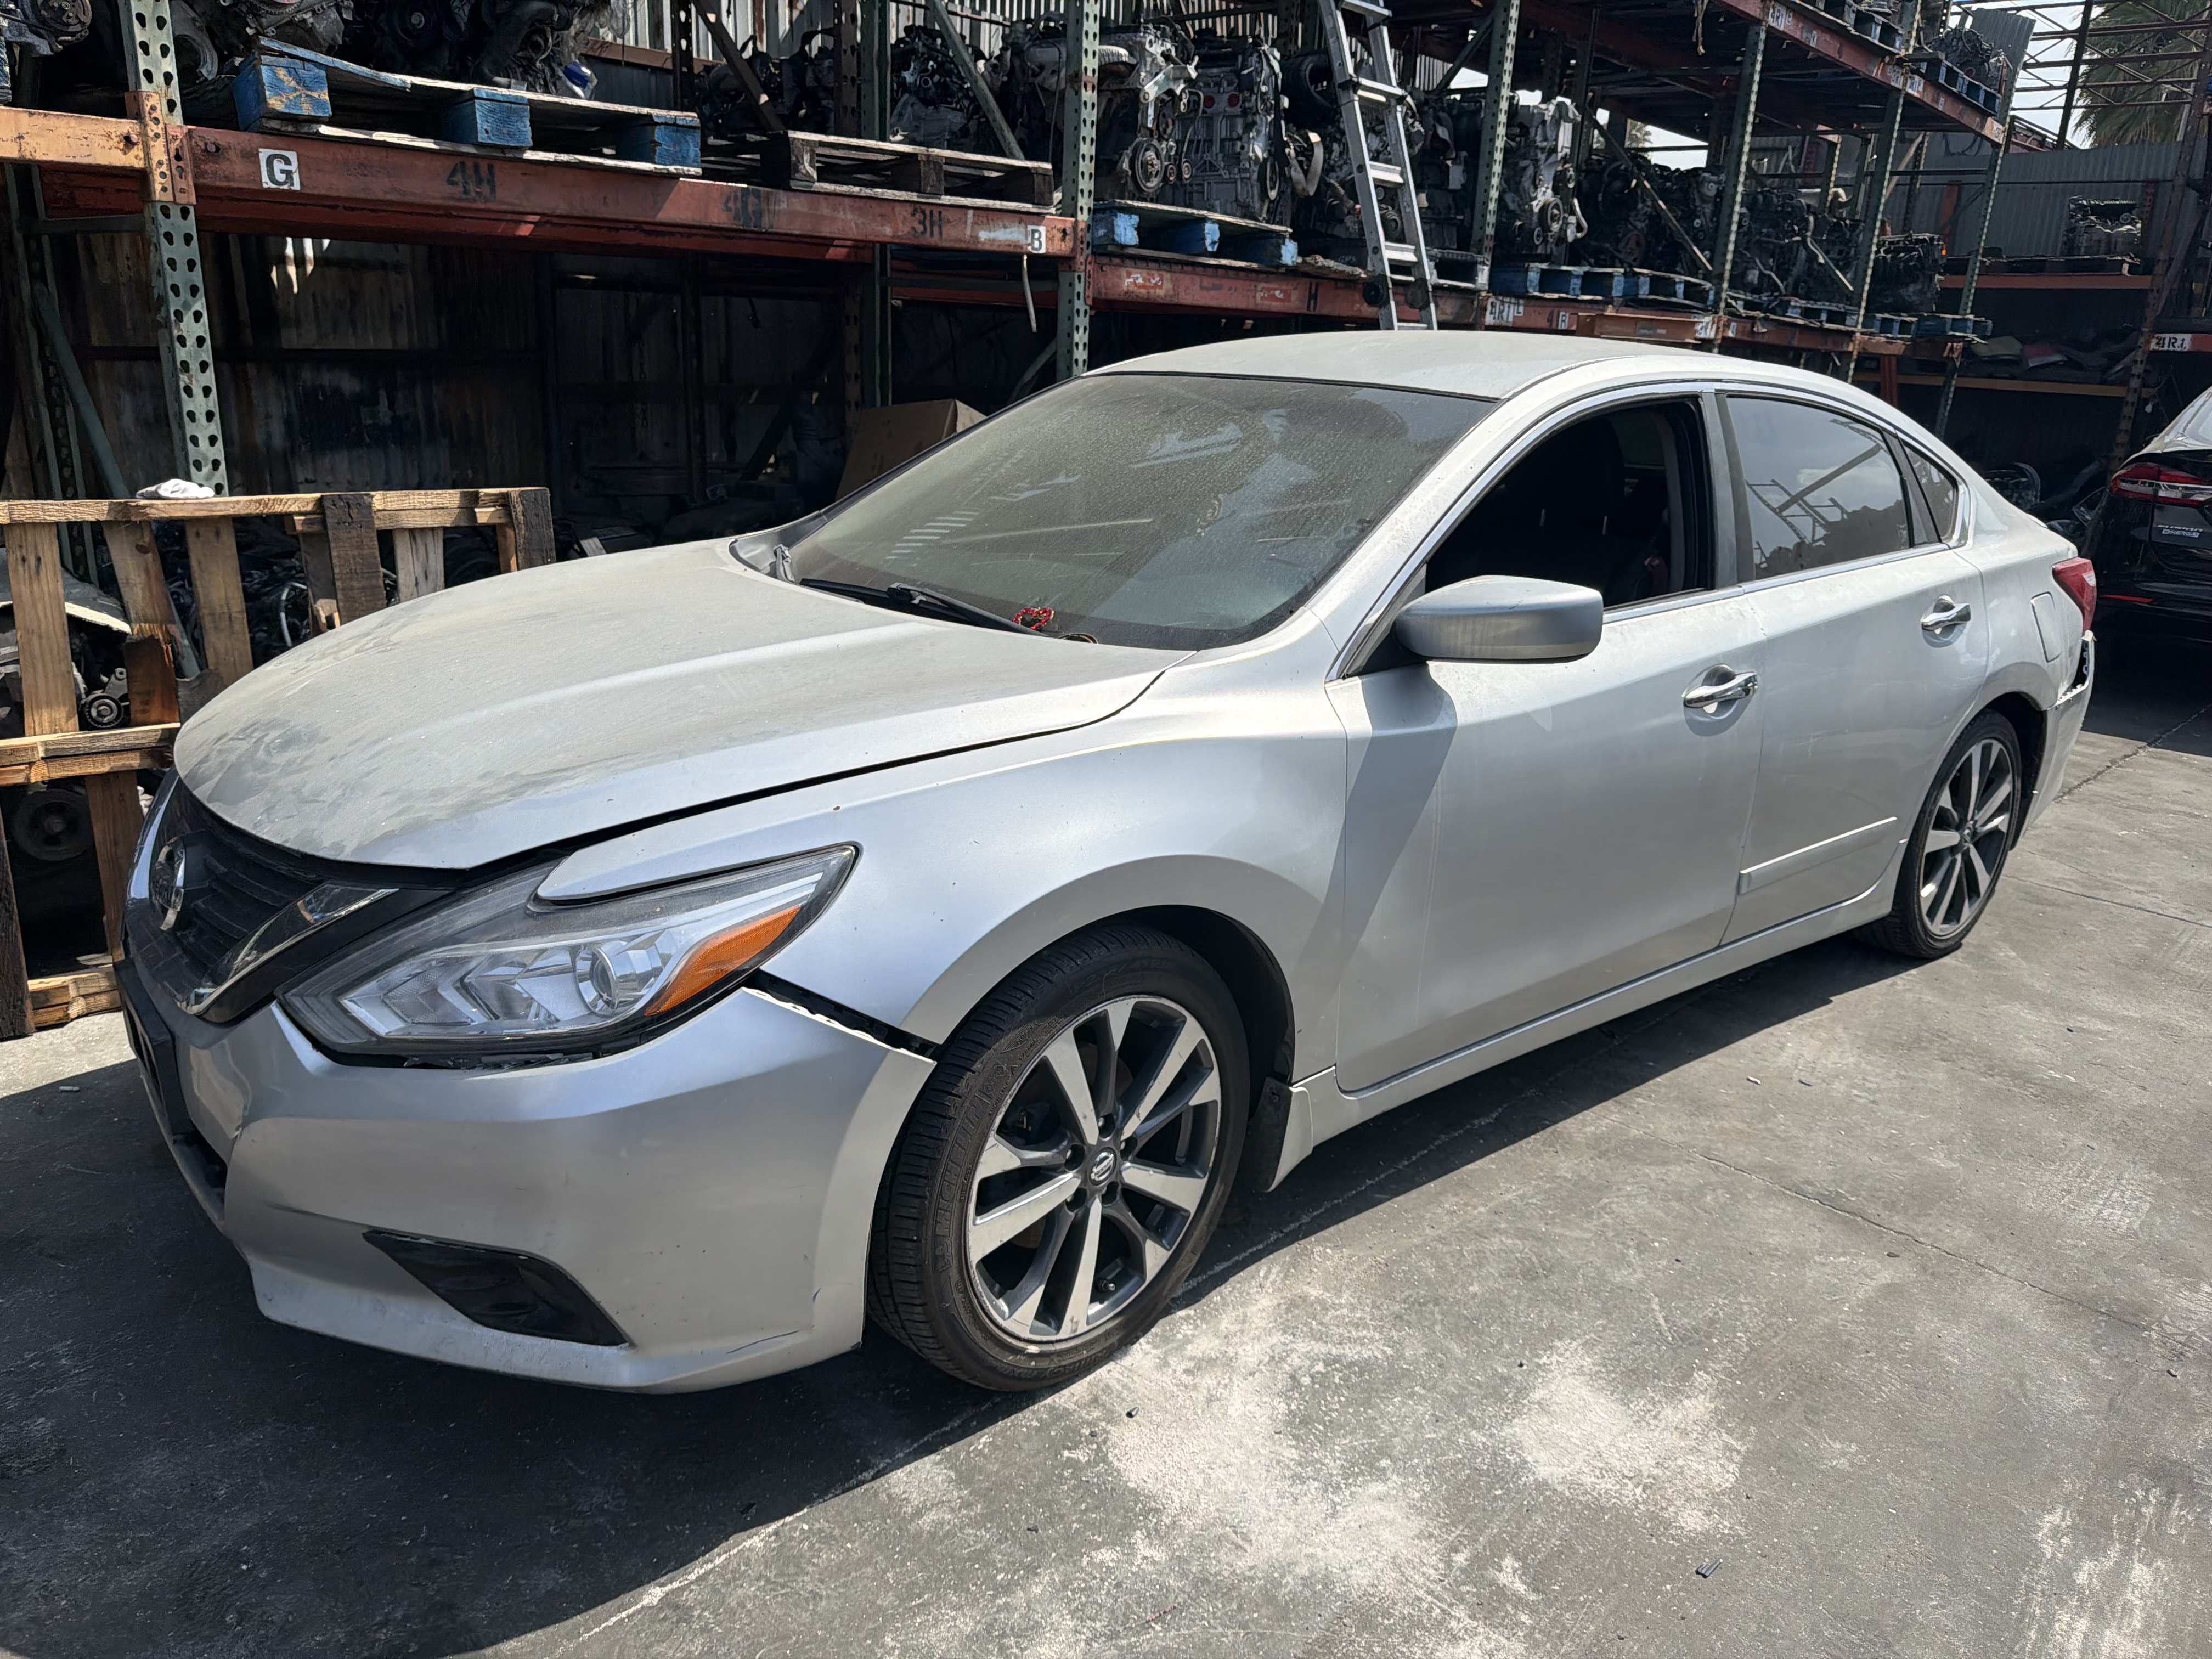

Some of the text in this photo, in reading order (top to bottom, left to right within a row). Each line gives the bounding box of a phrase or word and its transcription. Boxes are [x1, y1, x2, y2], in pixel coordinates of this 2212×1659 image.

[266, 153, 295, 187] G
[911, 206, 943, 240] 3H
[1030, 228, 1042, 251] B
[1560, 314, 1568, 329] R
